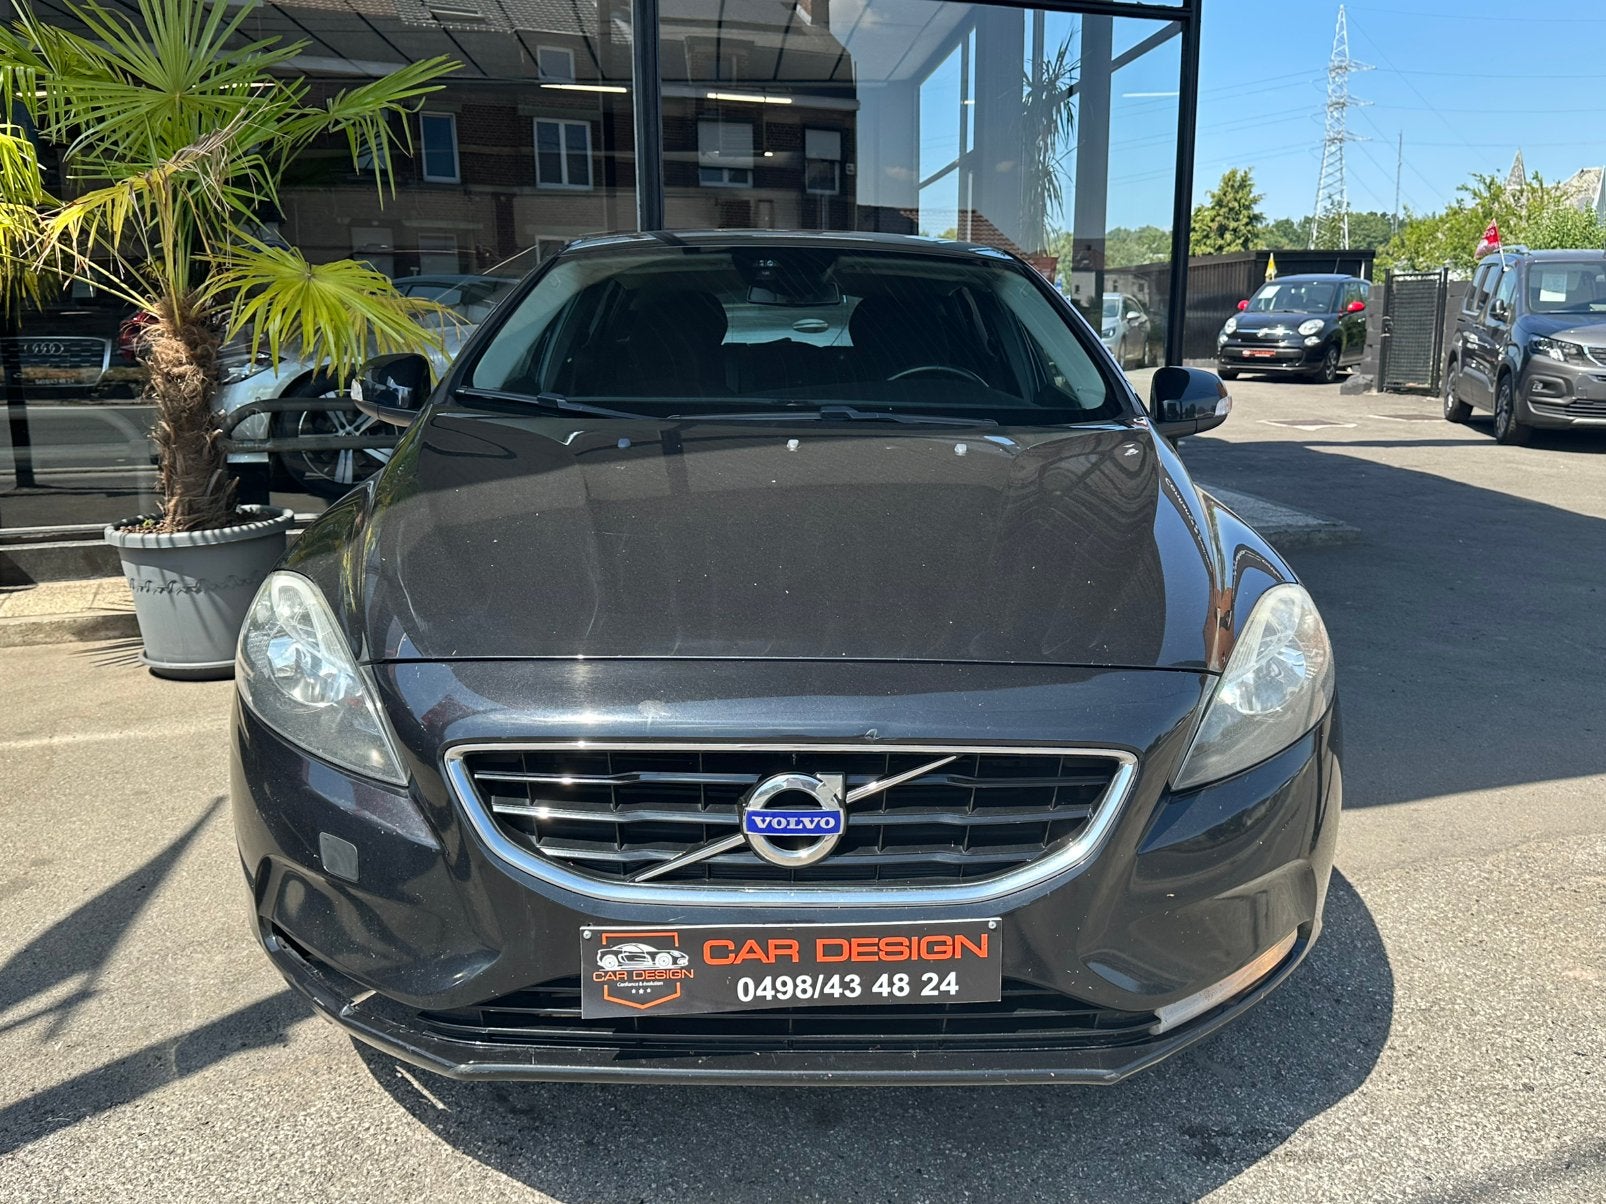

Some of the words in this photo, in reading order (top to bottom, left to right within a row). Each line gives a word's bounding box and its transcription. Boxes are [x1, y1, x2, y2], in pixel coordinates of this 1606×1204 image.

[751, 816, 835, 829] VOLVO
[703, 938, 799, 966] CAR
[815, 933, 989, 963] DESIGN
[593, 971, 627, 981] CAR
[633, 969, 694, 980] DESIGN
[736, 973, 862, 1002] 0498/43
[871, 973, 910, 998] 48
[920, 971, 959, 996] 24
